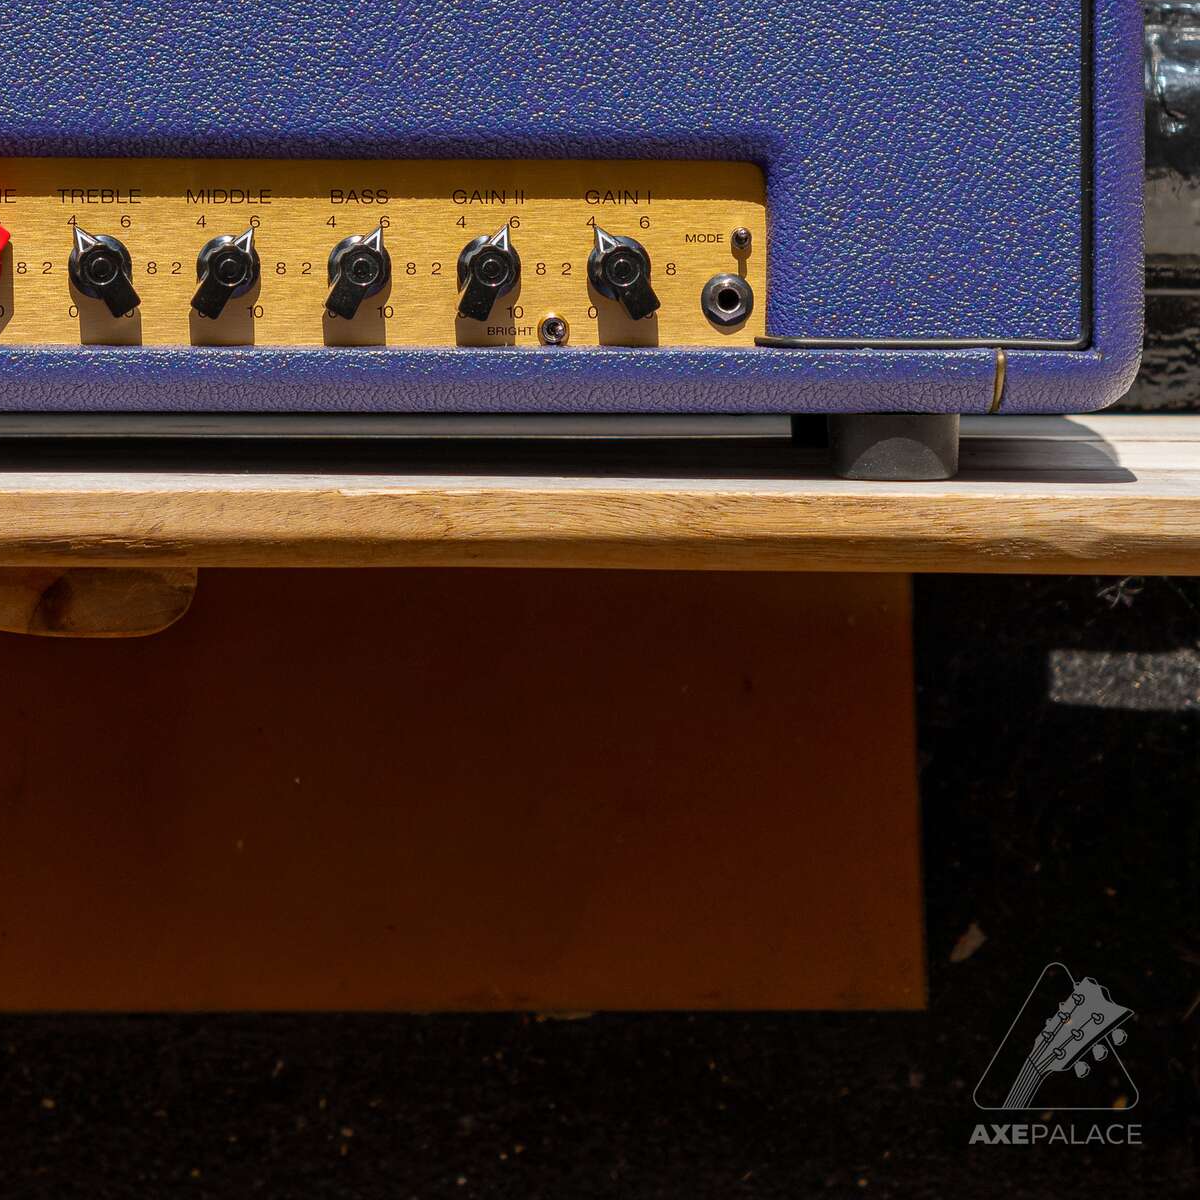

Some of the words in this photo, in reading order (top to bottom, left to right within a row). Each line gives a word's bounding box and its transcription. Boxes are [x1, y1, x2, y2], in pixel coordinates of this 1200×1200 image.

[57, 189, 141, 204] TREBLE
[187, 189, 272, 204] MIDDLE
[331, 189, 389, 204] BASS
[452, 190, 506, 204] GAIN
[514, 190, 525, 204] II
[585, 190, 639, 205] GAIN
[67, 215, 78, 228] 4
[120, 216, 131, 228] 6
[196, 215, 207, 228] 4
[249, 216, 260, 228] 6
[326, 216, 337, 228] 4
[379, 216, 390, 228] 6
[456, 216, 467, 228] 4
[509, 216, 520, 228] 6
[586, 216, 597, 228] 4
[639, 216, 650, 229] 6
[685, 234, 723, 243] MODE
[17, 262, 27, 274] 8
[42, 262, 52, 274] 2
[147, 262, 157, 275] 8
[172, 262, 182, 275] 2
[276, 262, 286, 275] 8
[302, 262, 311, 275] 2
[406, 262, 417, 275] 8
[431, 263, 441, 275] 2
[536, 263, 546, 275] 8
[561, 263, 571, 275] 2
[666, 263, 676, 276] 8
[248, 305, 264, 318] 10
[377, 306, 393, 318] 10
[507, 306, 524, 319] 10
[487, 327, 534, 336] BRIGHT
